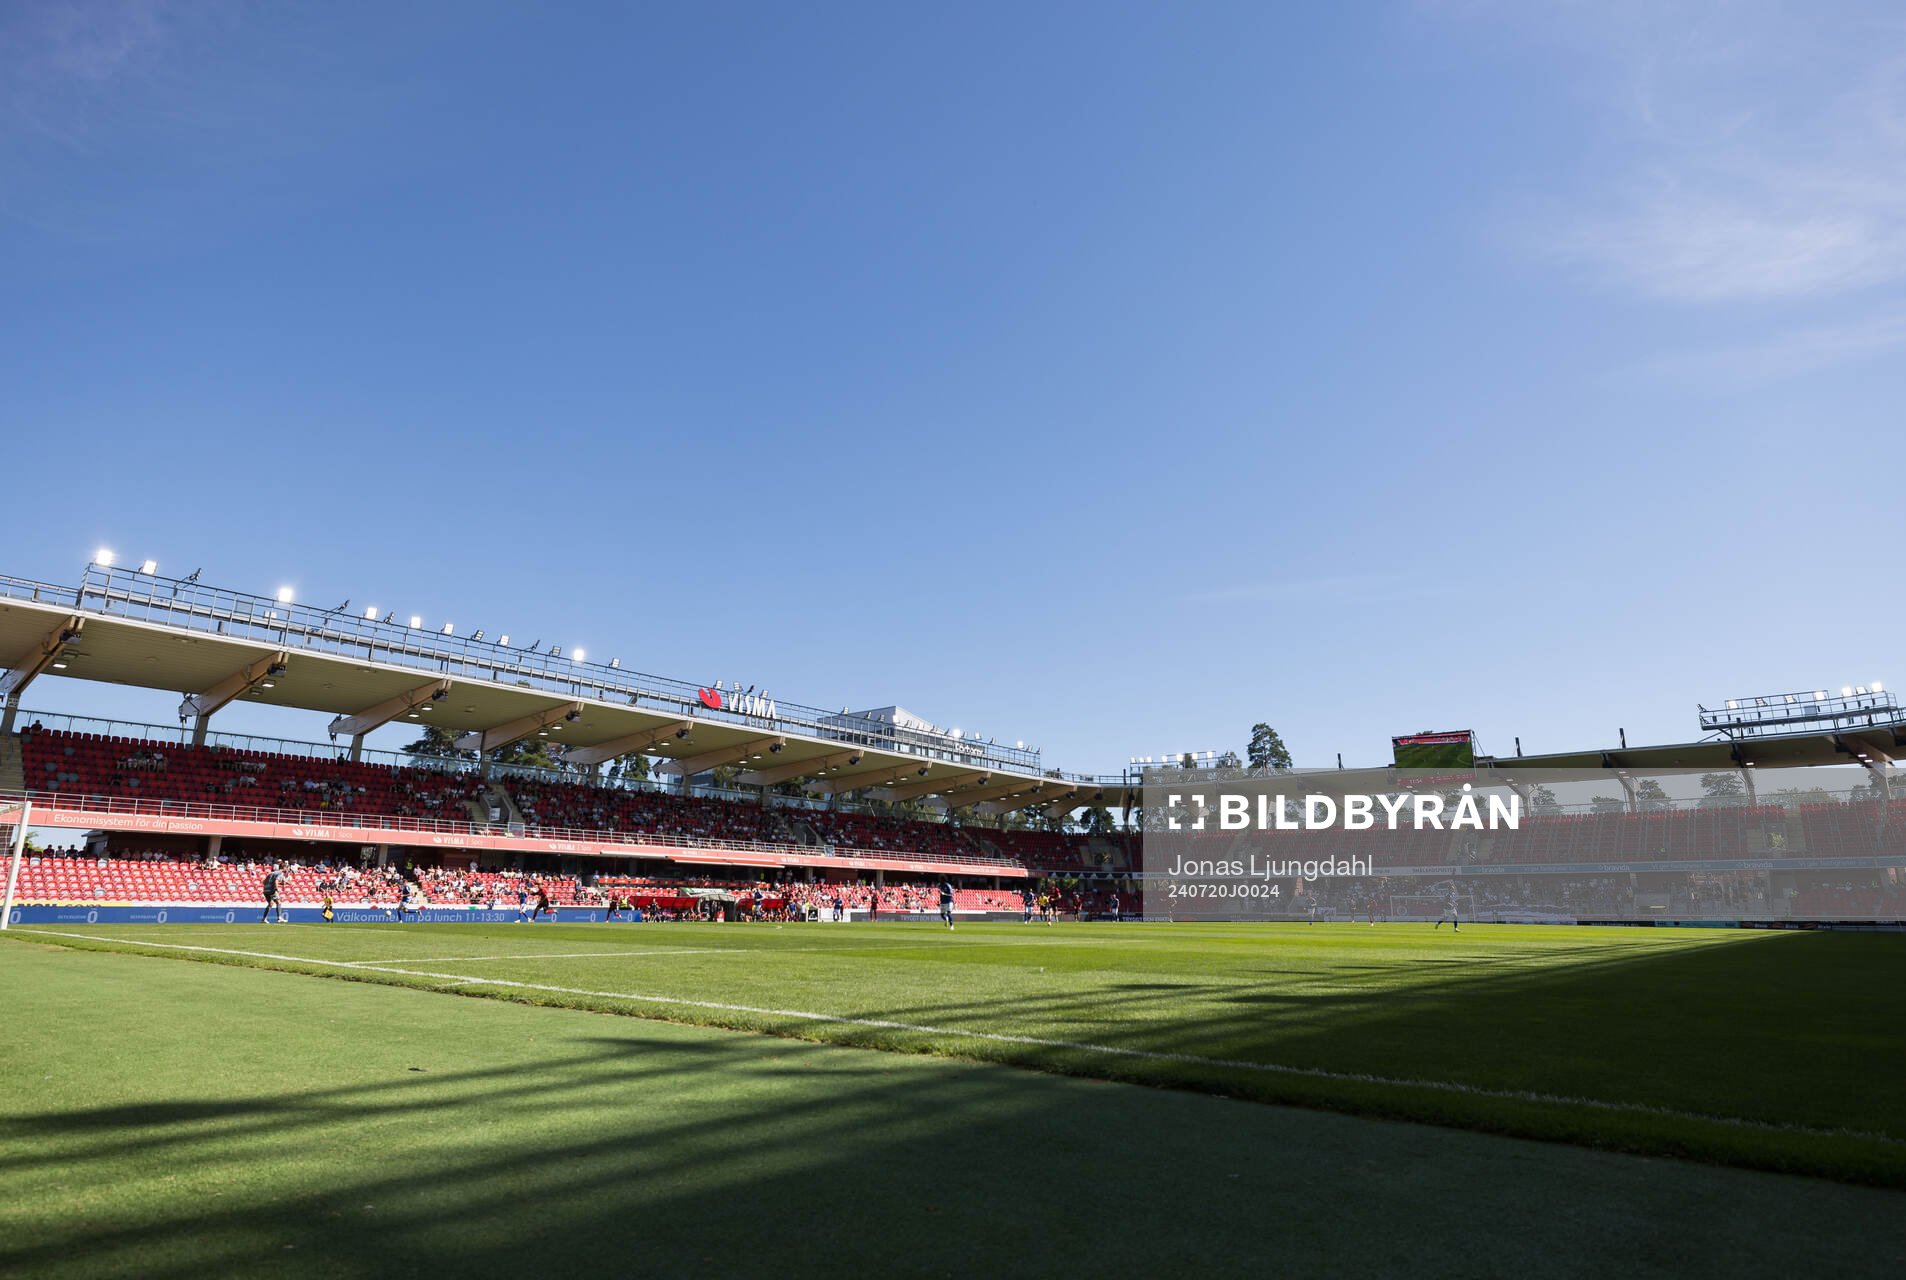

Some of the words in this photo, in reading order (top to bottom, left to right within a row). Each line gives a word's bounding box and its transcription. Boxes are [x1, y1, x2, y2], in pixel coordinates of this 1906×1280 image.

[729, 692, 777, 719] VISMA
[54, 814, 133, 827] Ekonomisystem
[136, 818, 151, 827] för
[153, 820, 167, 829] din
[168, 822, 203, 831] passion
[305, 829, 330, 838] VISMA
[434, 912, 462, 922] lunch
[465, 912, 505, 922] 11-13:30
